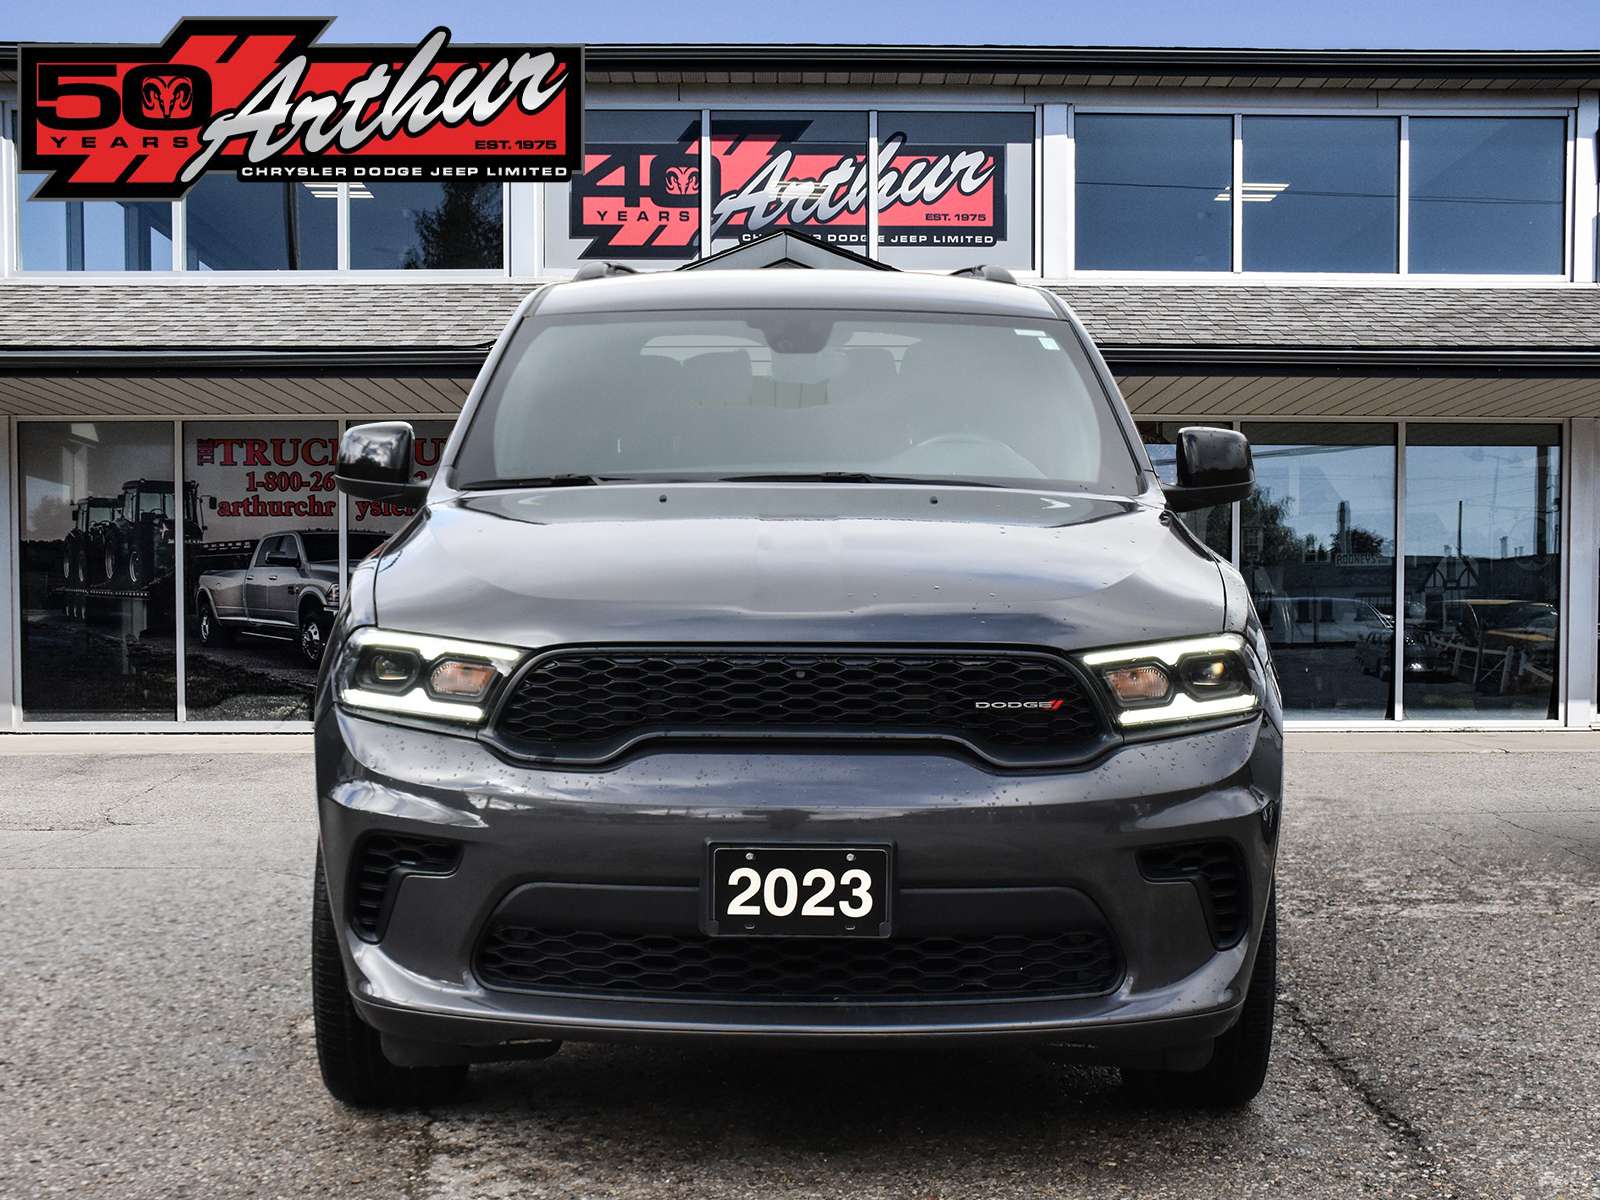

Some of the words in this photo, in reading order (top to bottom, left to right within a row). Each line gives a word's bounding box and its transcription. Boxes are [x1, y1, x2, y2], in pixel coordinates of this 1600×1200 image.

[711, 138, 996, 231] Arthur
[597, 211, 690, 222] YEARS
[925, 213, 951, 222] EST.
[955, 213, 986, 222] 1975
[891, 234, 928, 244] JEEP
[934, 234, 994, 244] LIMITED
[975, 701, 1053, 709] DODGE
[727, 867, 873, 918] 2023
